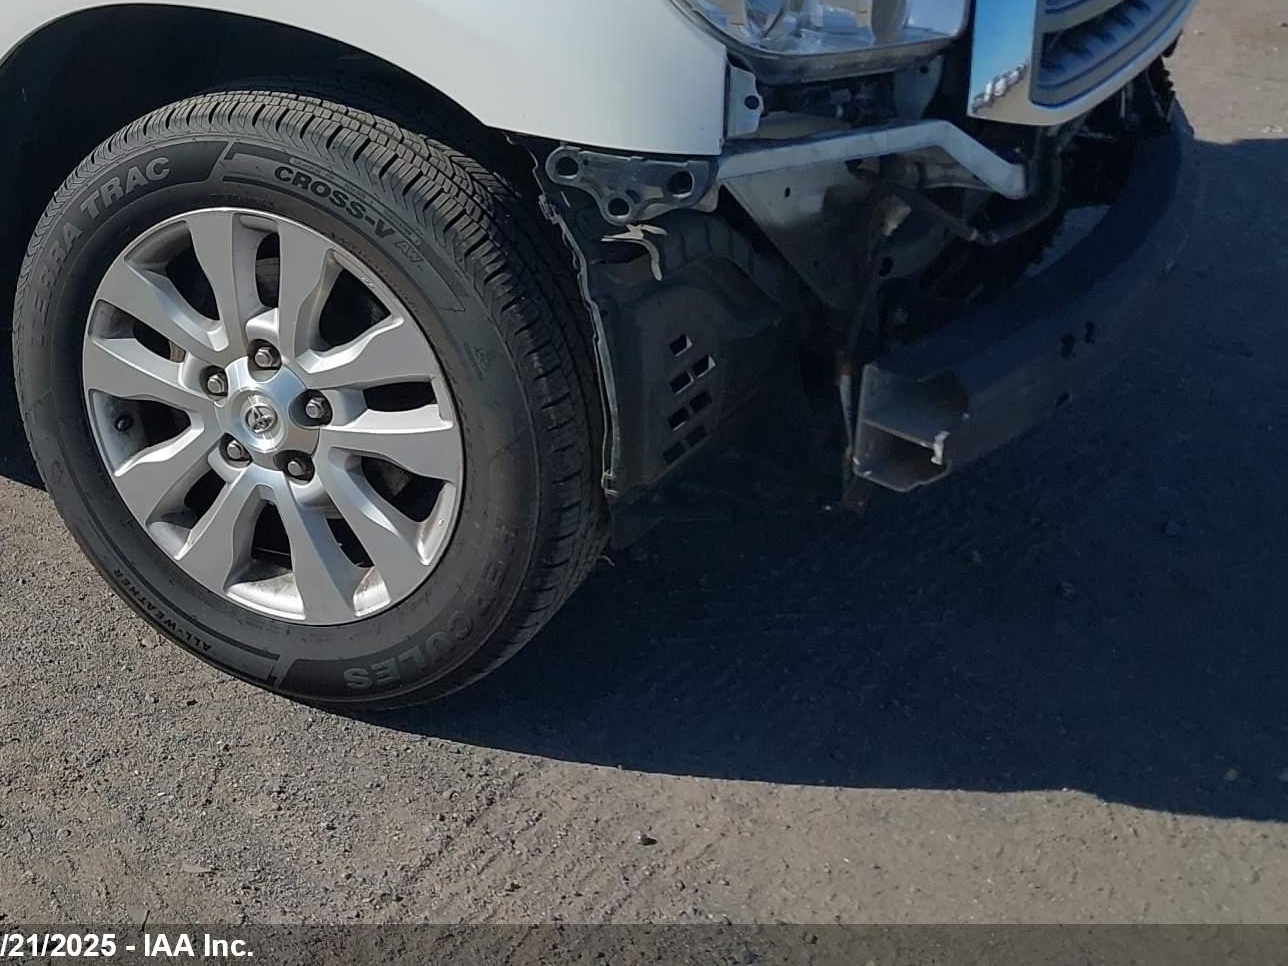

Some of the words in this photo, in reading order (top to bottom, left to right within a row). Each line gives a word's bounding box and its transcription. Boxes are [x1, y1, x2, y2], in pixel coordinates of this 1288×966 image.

[80, 157, 171, 220] TRAC
[274, 165, 396, 239] CROSS-V
[113, 568, 213, 652] ALL-WEATHER
